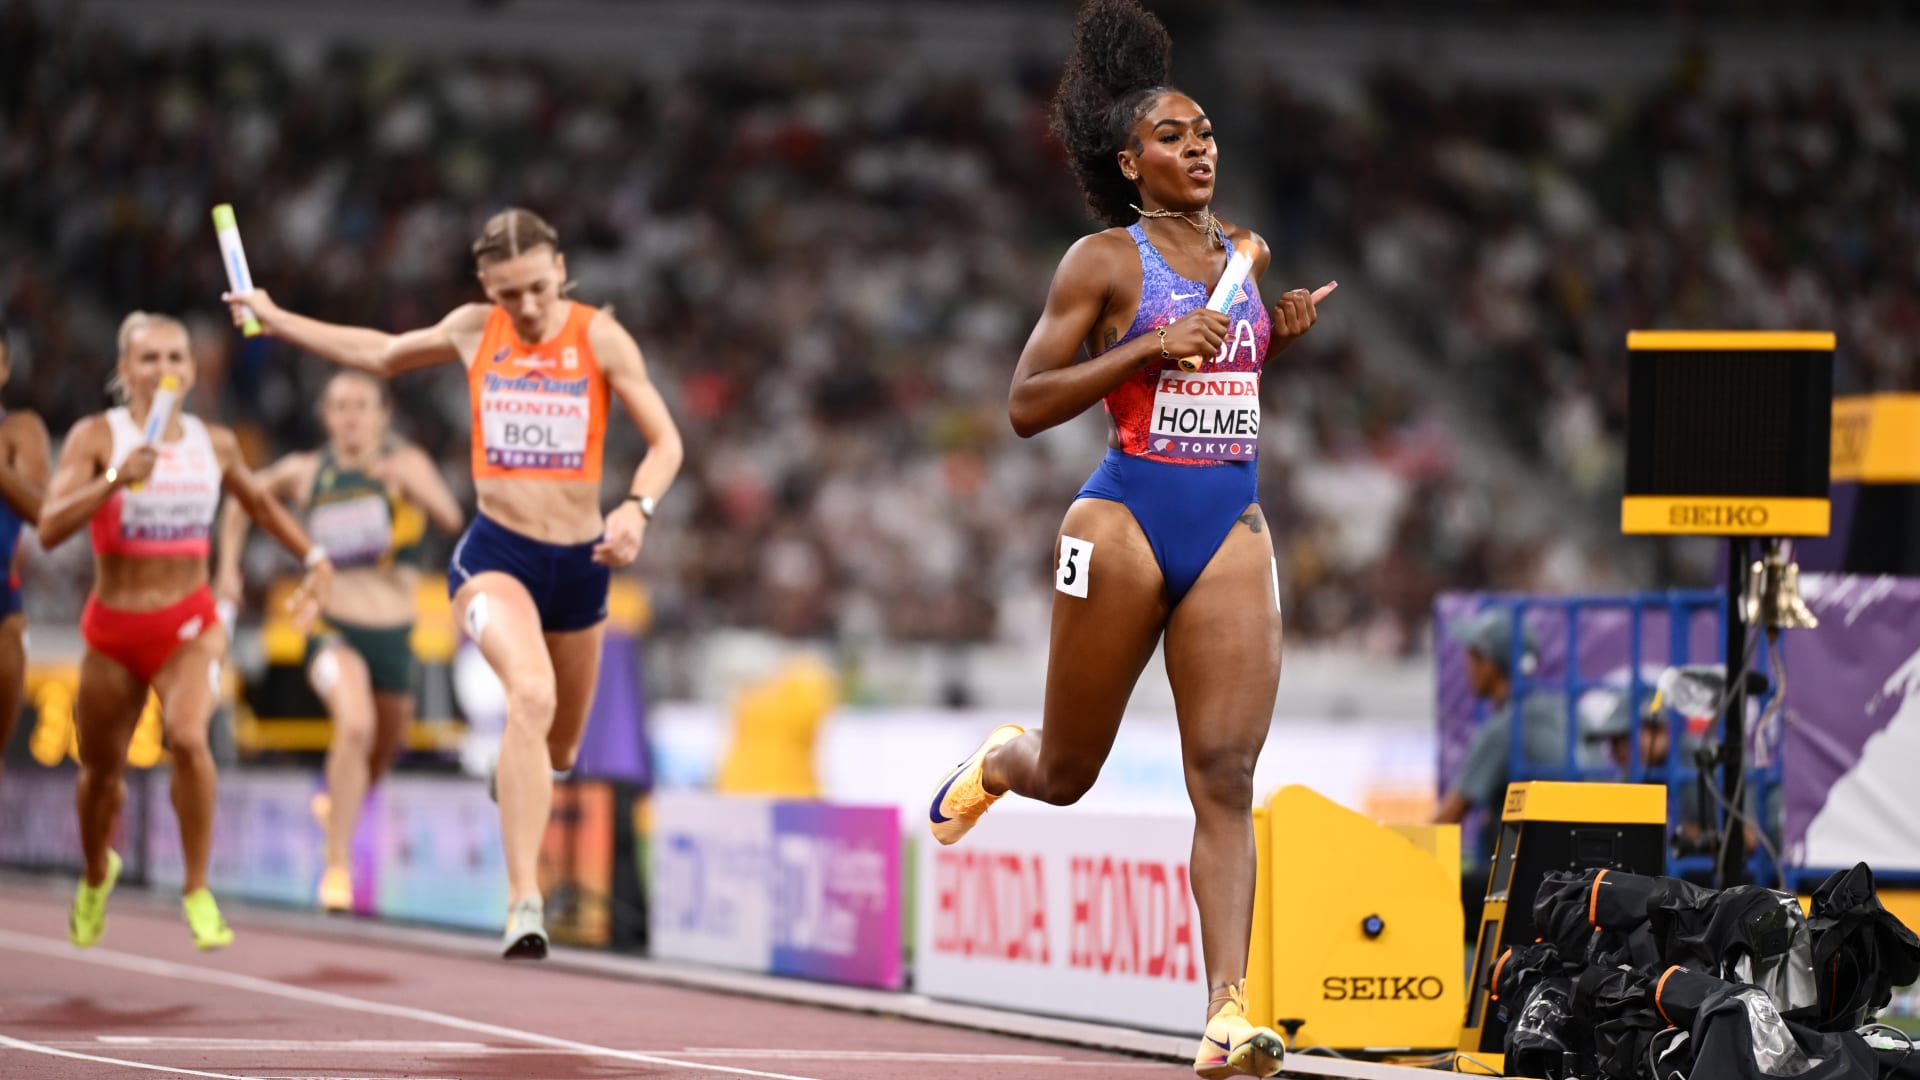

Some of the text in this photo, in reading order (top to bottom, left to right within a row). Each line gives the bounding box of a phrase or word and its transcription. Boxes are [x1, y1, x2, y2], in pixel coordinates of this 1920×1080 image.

[1159, 378, 1257, 397] HONDA
[485, 399, 583, 417] HONDA
[1158, 406, 1258, 435] HOLMES
[504, 423, 560, 448] BOL
[1668, 505, 1769, 527] SEIKO
[1063, 547, 1080, 586] 5
[934, 851, 1050, 965] HONDA
[1070, 855, 1197, 984] HONDA
[1323, 976, 1444, 1001] SEIKO
